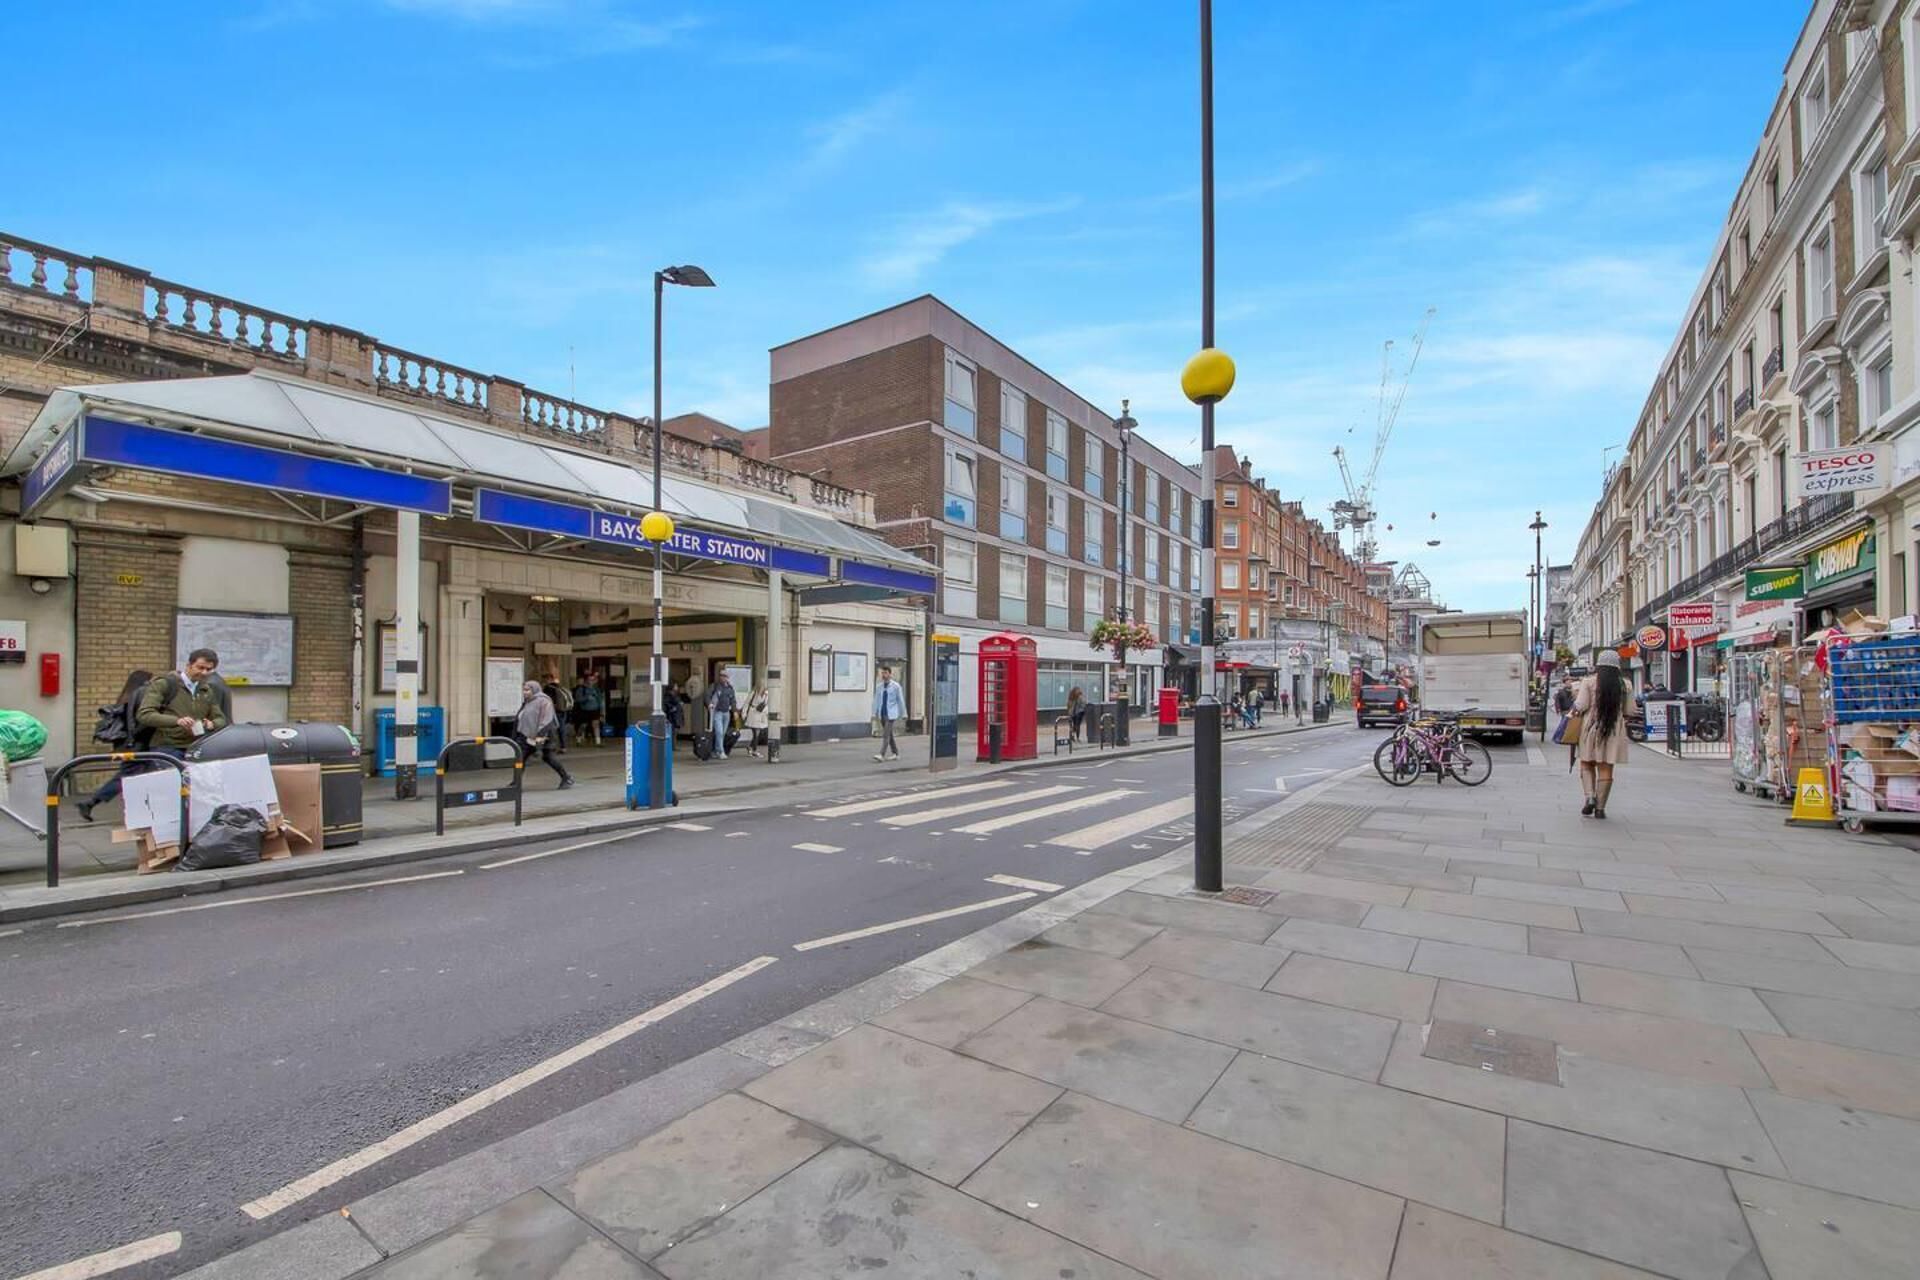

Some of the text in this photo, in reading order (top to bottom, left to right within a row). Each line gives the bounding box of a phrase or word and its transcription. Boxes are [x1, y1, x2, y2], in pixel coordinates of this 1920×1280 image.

[1802, 453, 1875, 471] TESCO
[1805, 473, 1875, 491] express
[601, 519, 766, 562] BAYSATER STATION
[1815, 529, 1868, 582] SUBWAY
[1749, 573, 1800, 596] SUBWAY
[1671, 606, 1712, 615] Ristorante
[1671, 616, 1712, 625] Italiano
